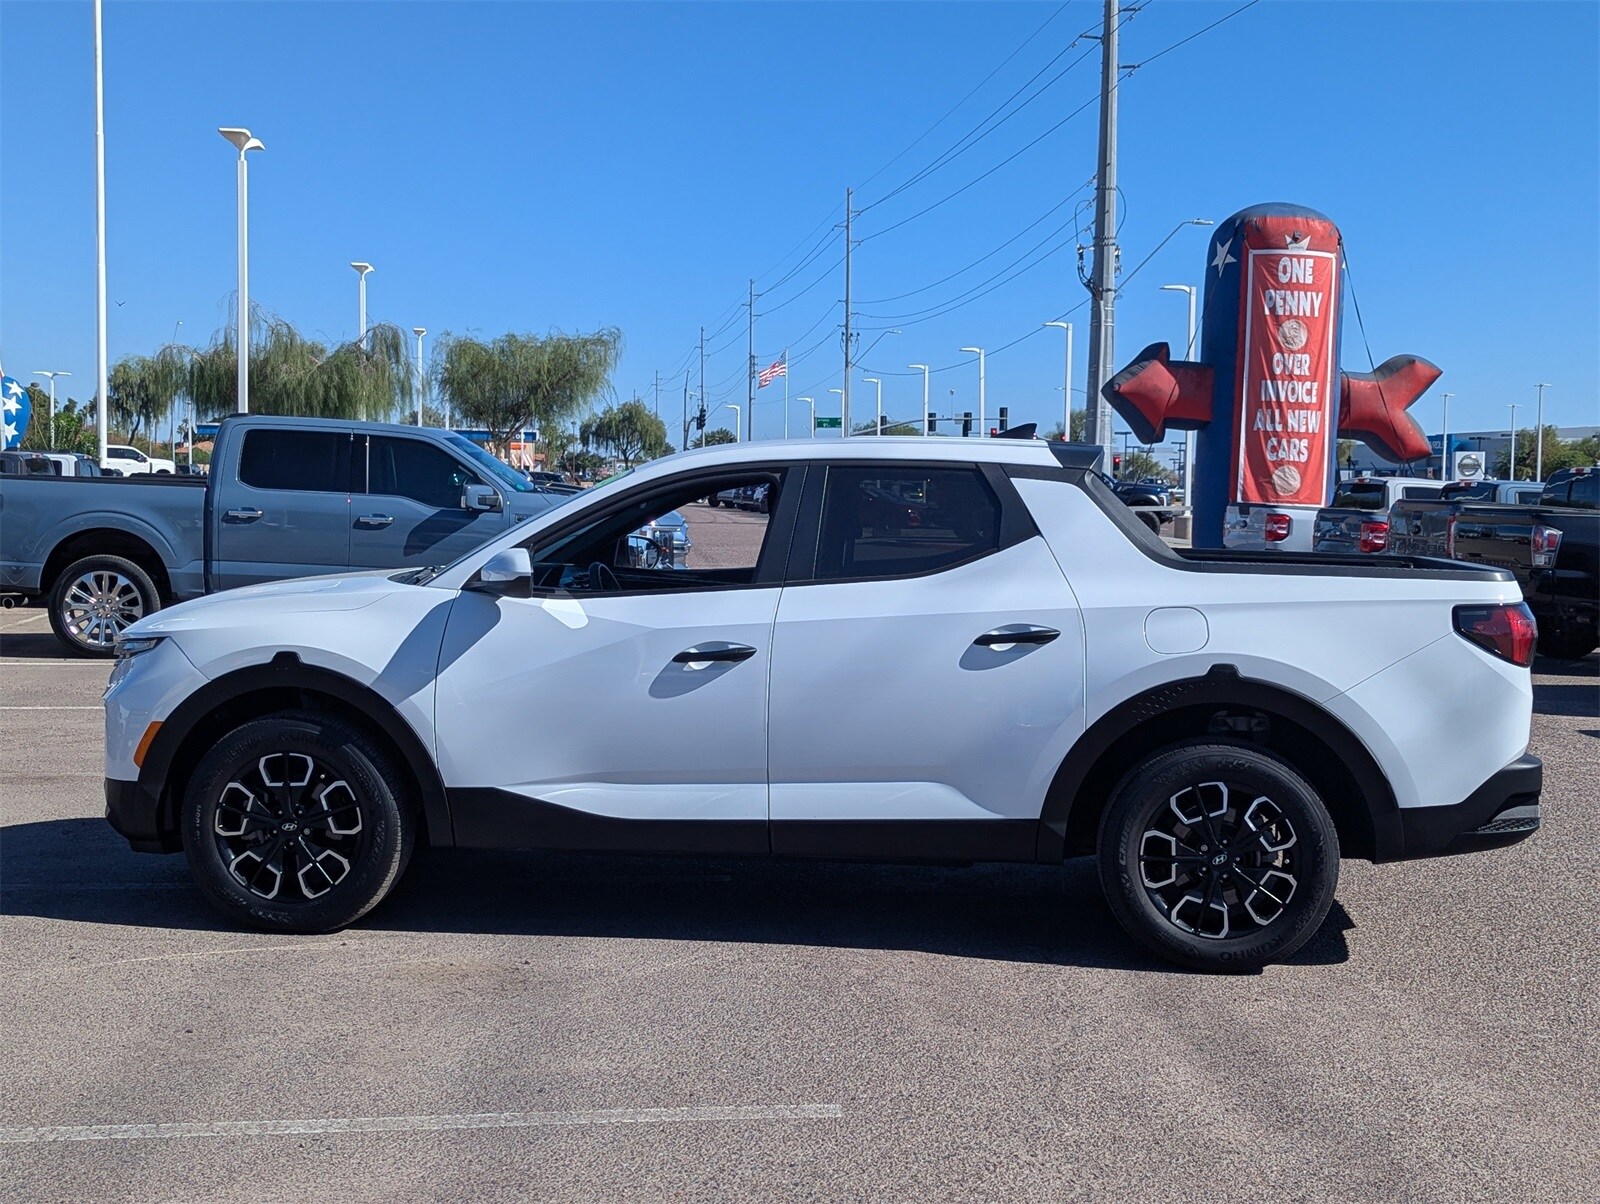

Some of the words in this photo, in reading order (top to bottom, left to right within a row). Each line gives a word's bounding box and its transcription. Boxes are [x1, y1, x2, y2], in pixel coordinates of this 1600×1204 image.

[1278, 256, 1314, 284] ONE
[1264, 289, 1323, 317] PENNY
[1272, 352, 1310, 376] OVER
[1261, 380, 1318, 403] INVOICE
[1253, 408, 1283, 432] ALL
[1287, 410, 1321, 434] NEW
[1266, 437, 1309, 463] CARS
